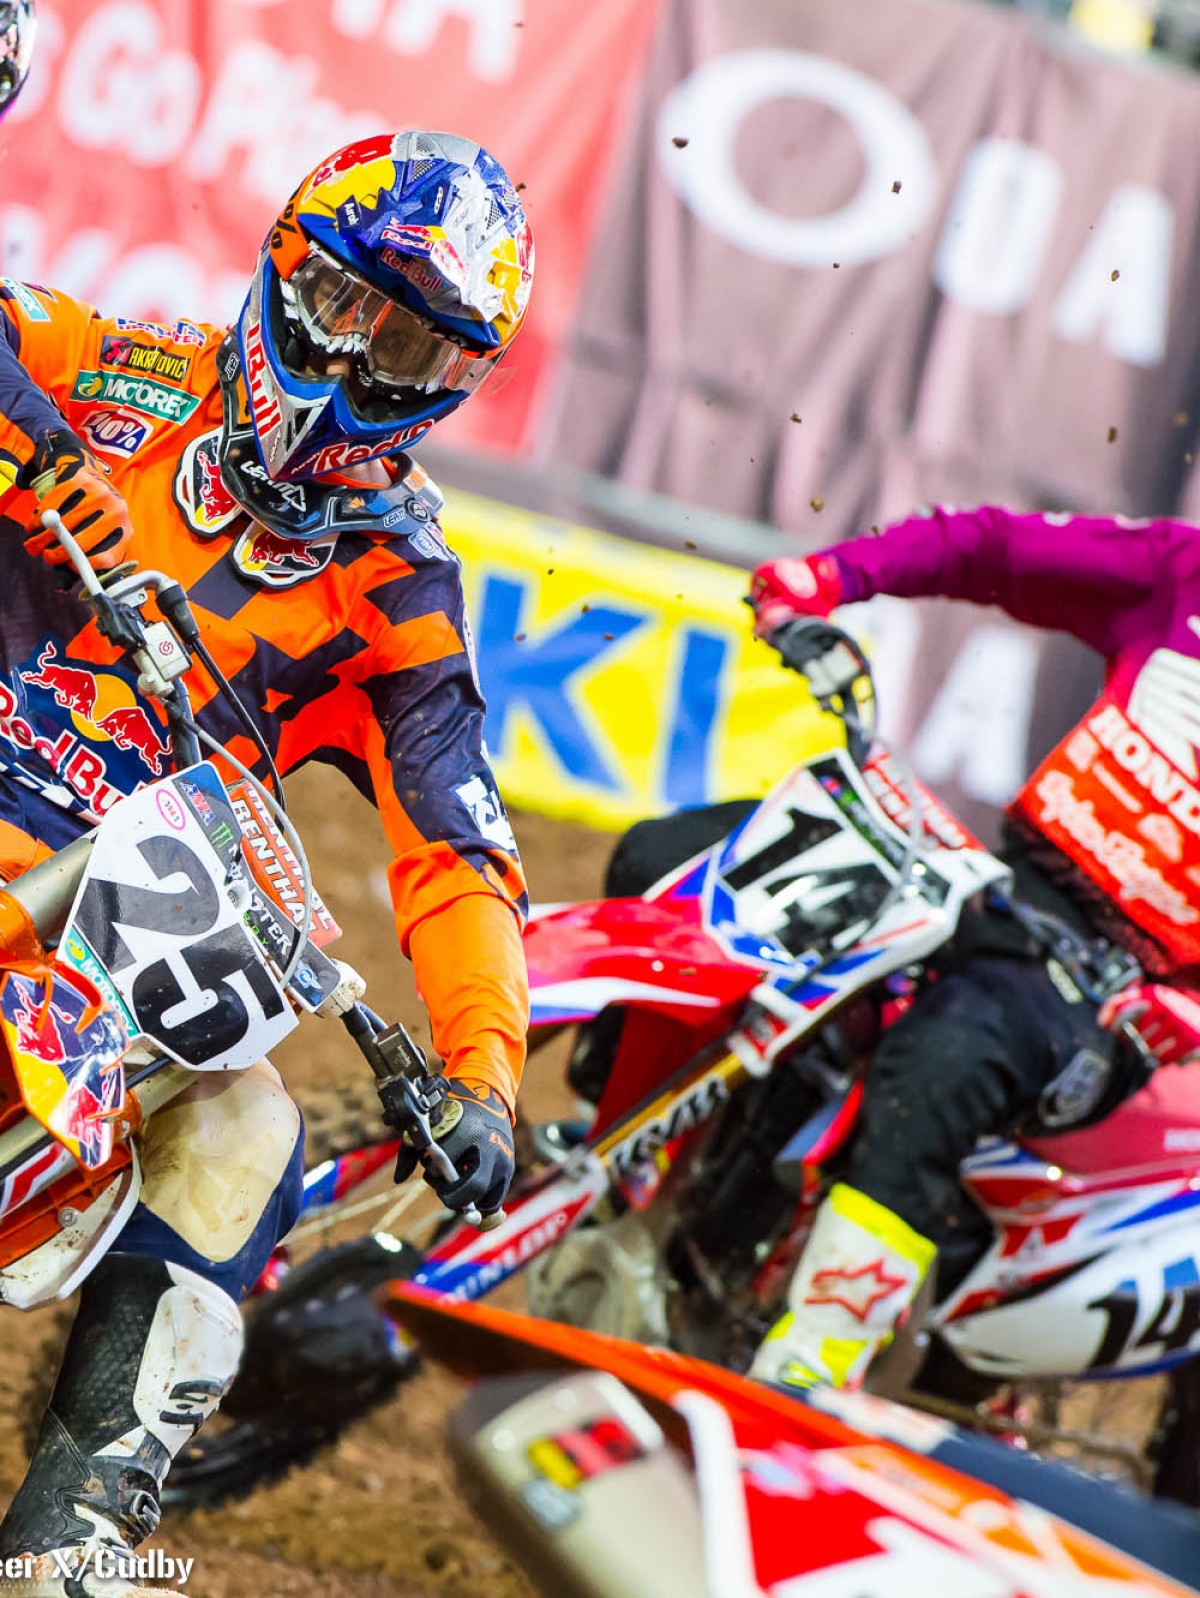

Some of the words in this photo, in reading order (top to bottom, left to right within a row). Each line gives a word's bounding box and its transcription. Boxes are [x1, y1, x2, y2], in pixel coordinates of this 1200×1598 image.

[380, 247, 413, 273] Red
[411, 260, 443, 291] Bull
[63, 744, 129, 818] Bu
[1086, 703, 1200, 834] HOND
[74, 834, 285, 1066] 25
[80, 958, 135, 1033] MOTOREX
